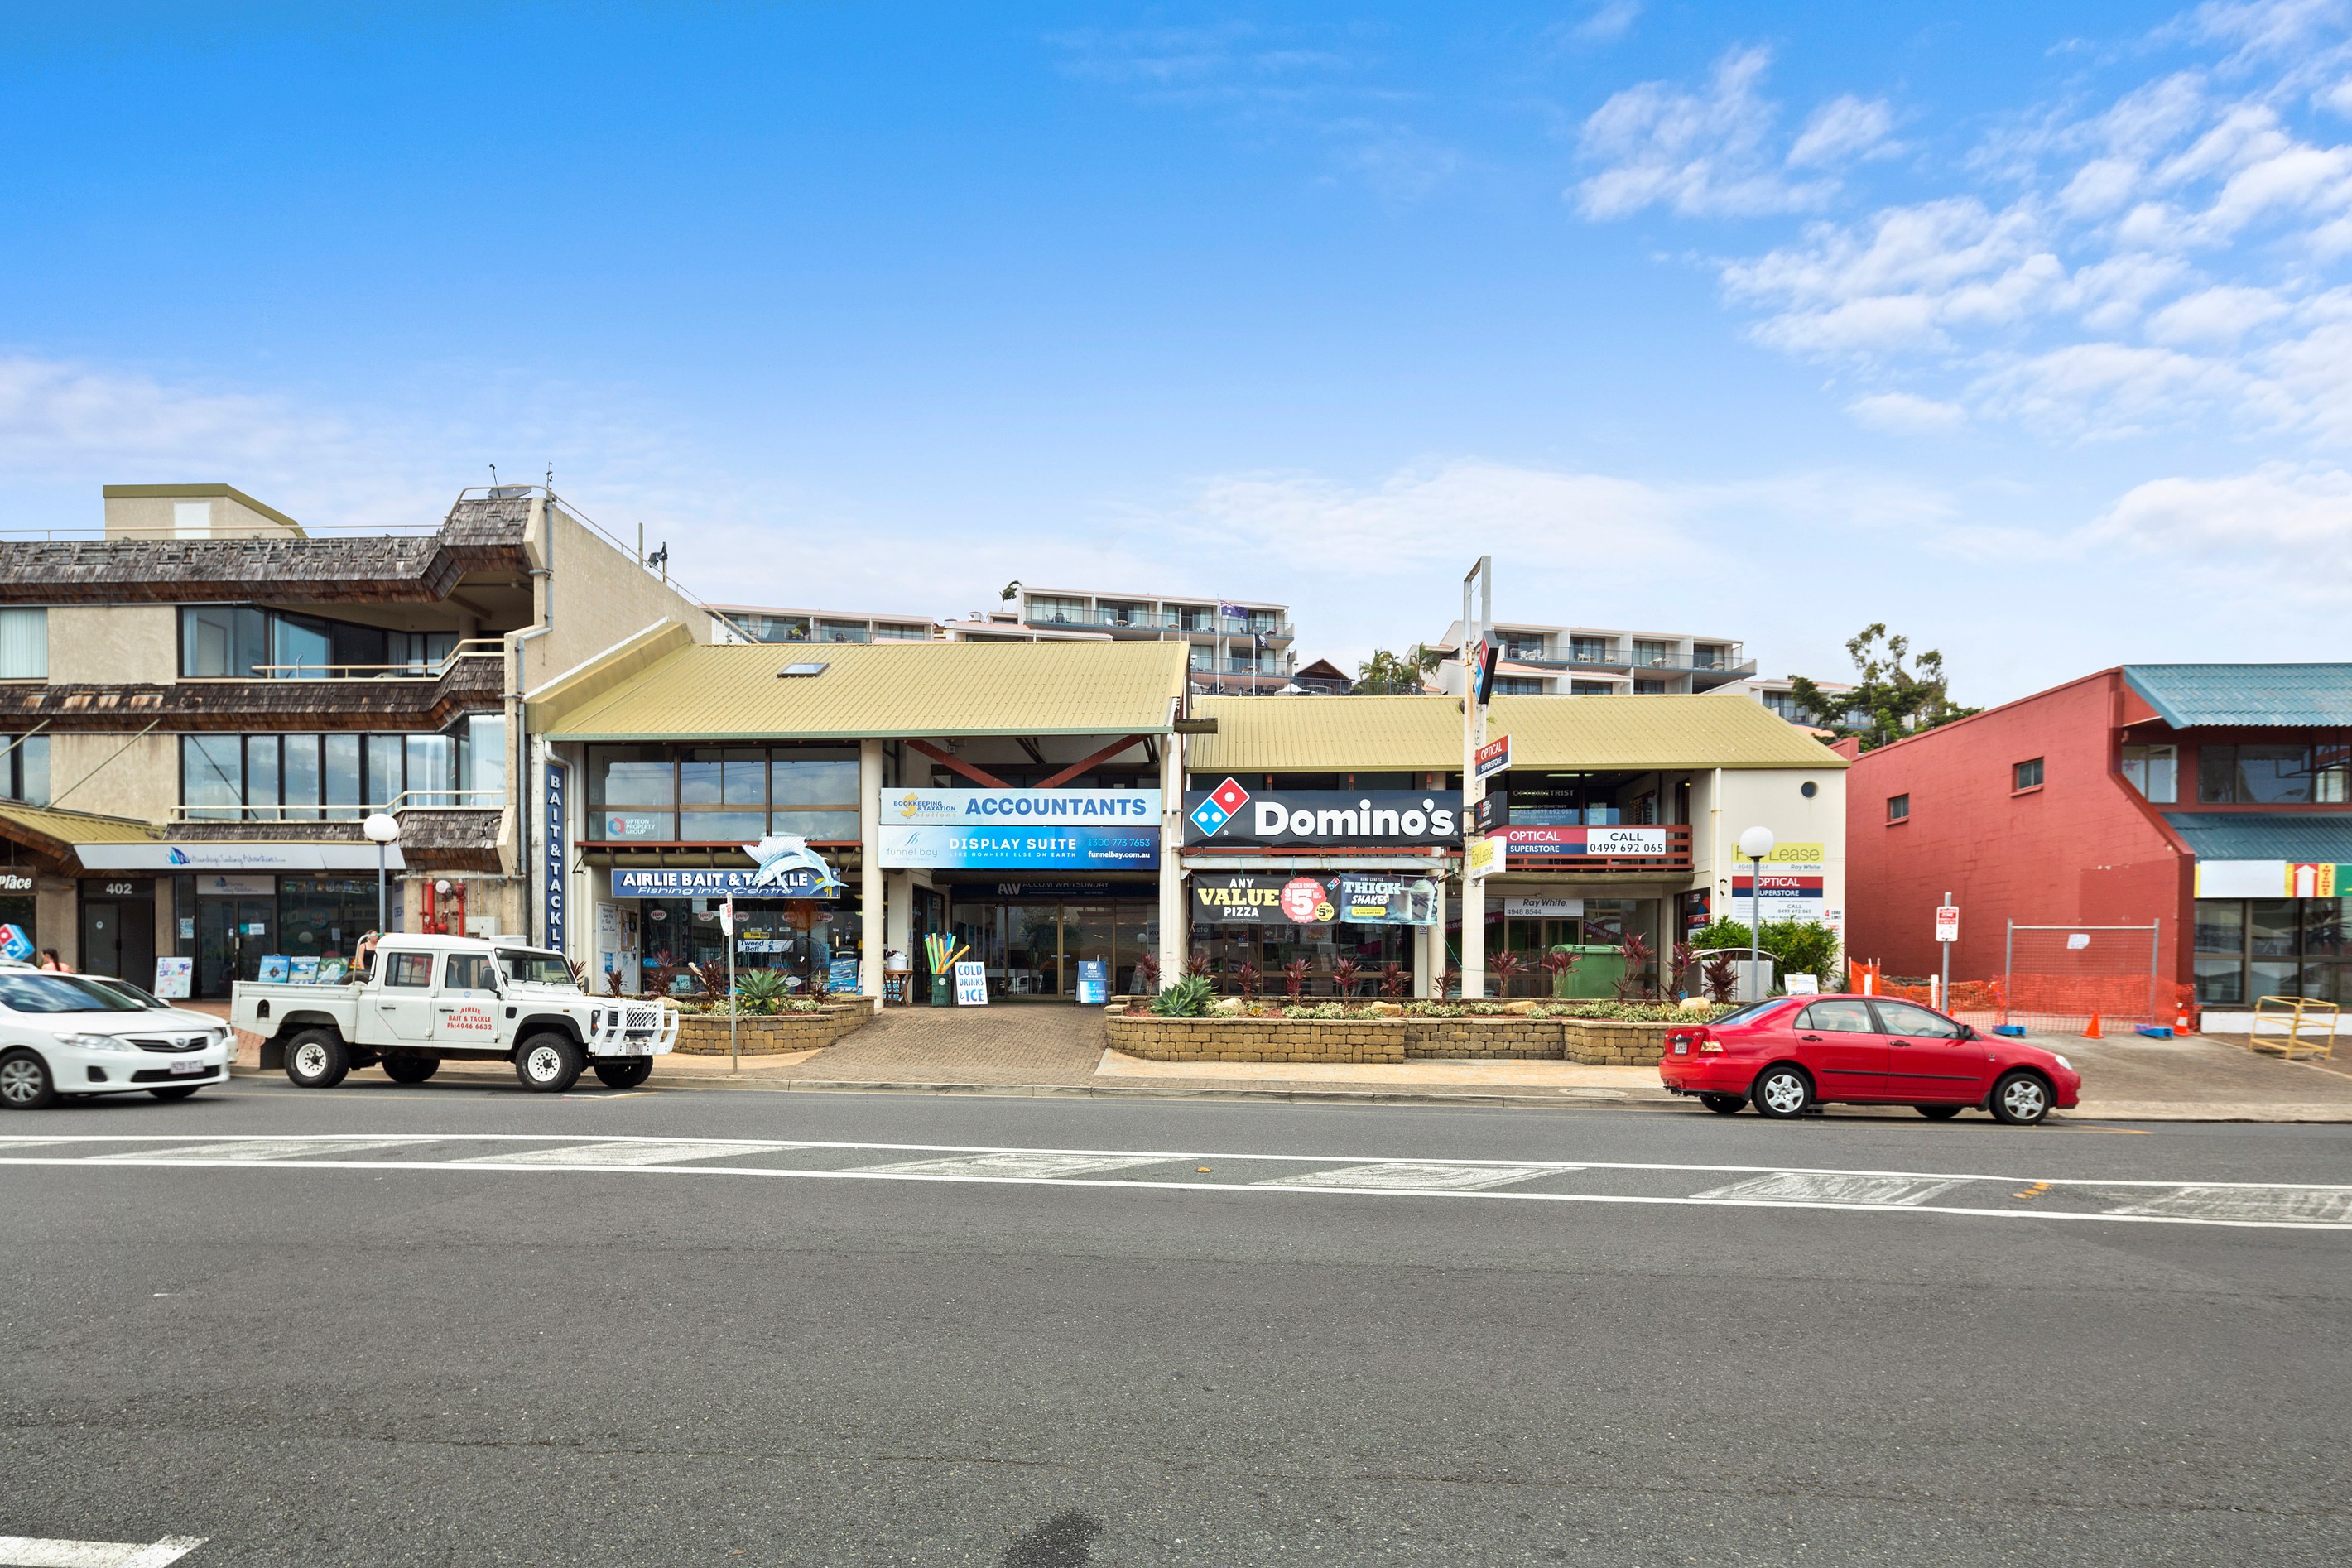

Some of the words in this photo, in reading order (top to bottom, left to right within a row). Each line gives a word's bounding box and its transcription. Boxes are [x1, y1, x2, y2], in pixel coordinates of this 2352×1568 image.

[1480, 742, 1503, 760] OPTICAL
[1480, 756, 1502, 772] SUPERSTORE
[549, 775, 561, 838] BAIT
[965, 798, 1147, 816] ACCOUNTANTS
[1255, 798, 1455, 836] Domino's
[1509, 831, 1560, 842] OPTICAL
[1610, 833, 1643, 841] CALL
[950, 838, 1020, 850] DISPLAY
[1027, 838, 1076, 850] SUITE
[1088, 839, 1110, 847] 1300
[1112, 839, 1128, 847] 773
[1130, 839, 1150, 847] 7653
[1590, 844, 1616, 852] 0499
[1620, 844, 1640, 852] 692
[1644, 844, 1663, 852] 065
[550, 843, 561, 857] &
[887, 848, 916, 856] funnel
[920, 848, 938, 857] bay
[1088, 851, 1150, 859] funnelbay.com.au
[623, 873, 677, 886] AIRLIE
[682, 873, 723, 886] BAIT
[728, 873, 741, 886] &
[742, 873, 808, 886] TKLE
[1229, 878, 1254, 888] ANY
[106, 883, 132, 894] 402
[638, 887, 695, 895] Fishing
[1343, 881, 1401, 894] THICK
[1198, 889, 1280, 906] VALUE
[1351, 895, 1388, 905] SHAKES
[1523, 899, 1540, 908] Ray
[1224, 907, 1259, 917] PIZZA
[958, 965, 982, 975] COLD
[959, 978, 984, 986] DRINKS
[966, 989, 984, 1002] ICE
